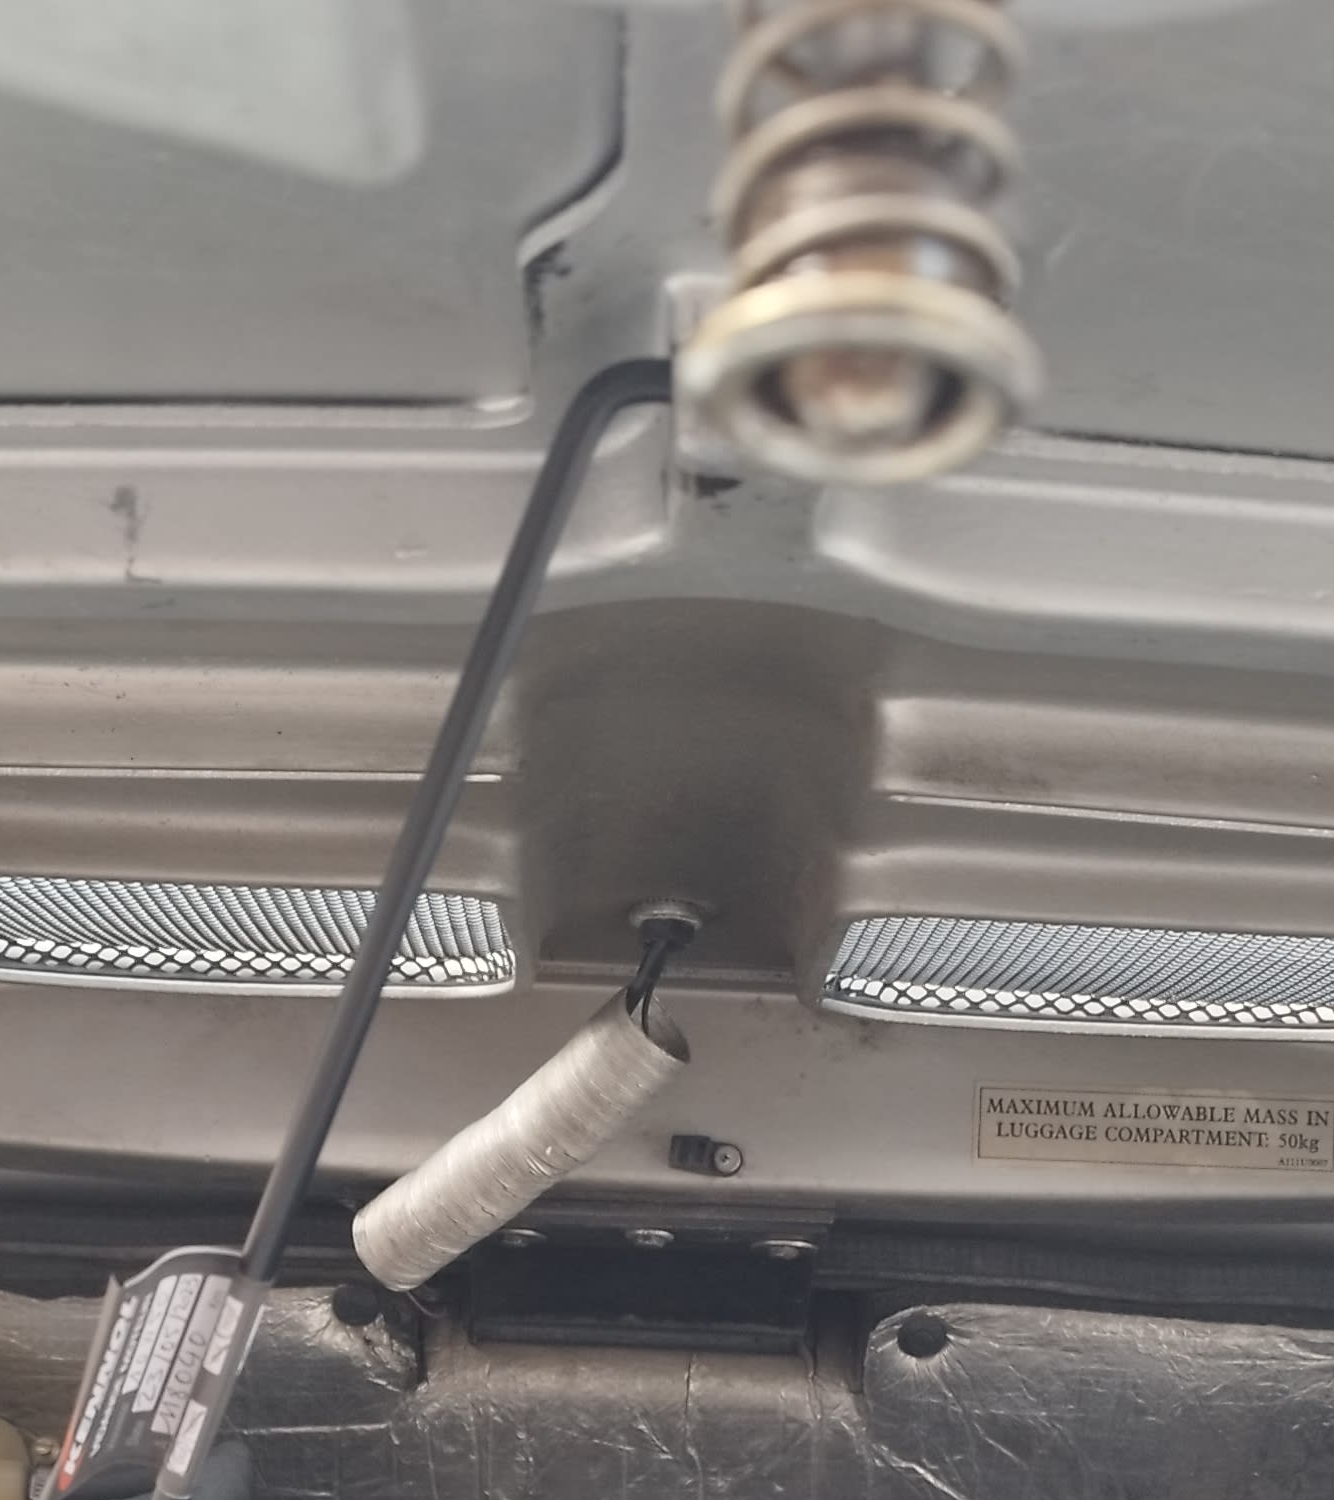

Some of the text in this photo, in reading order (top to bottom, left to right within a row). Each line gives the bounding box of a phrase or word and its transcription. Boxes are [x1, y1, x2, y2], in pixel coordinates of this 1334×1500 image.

[986, 1097, 1330, 1127] MAXIMUM ALLOWABLE MASS IN
[996, 1121, 1320, 1152] LUGGAGE COMPARTMENT: 50kg
[64, 1295, 137, 1475] KENNOL
